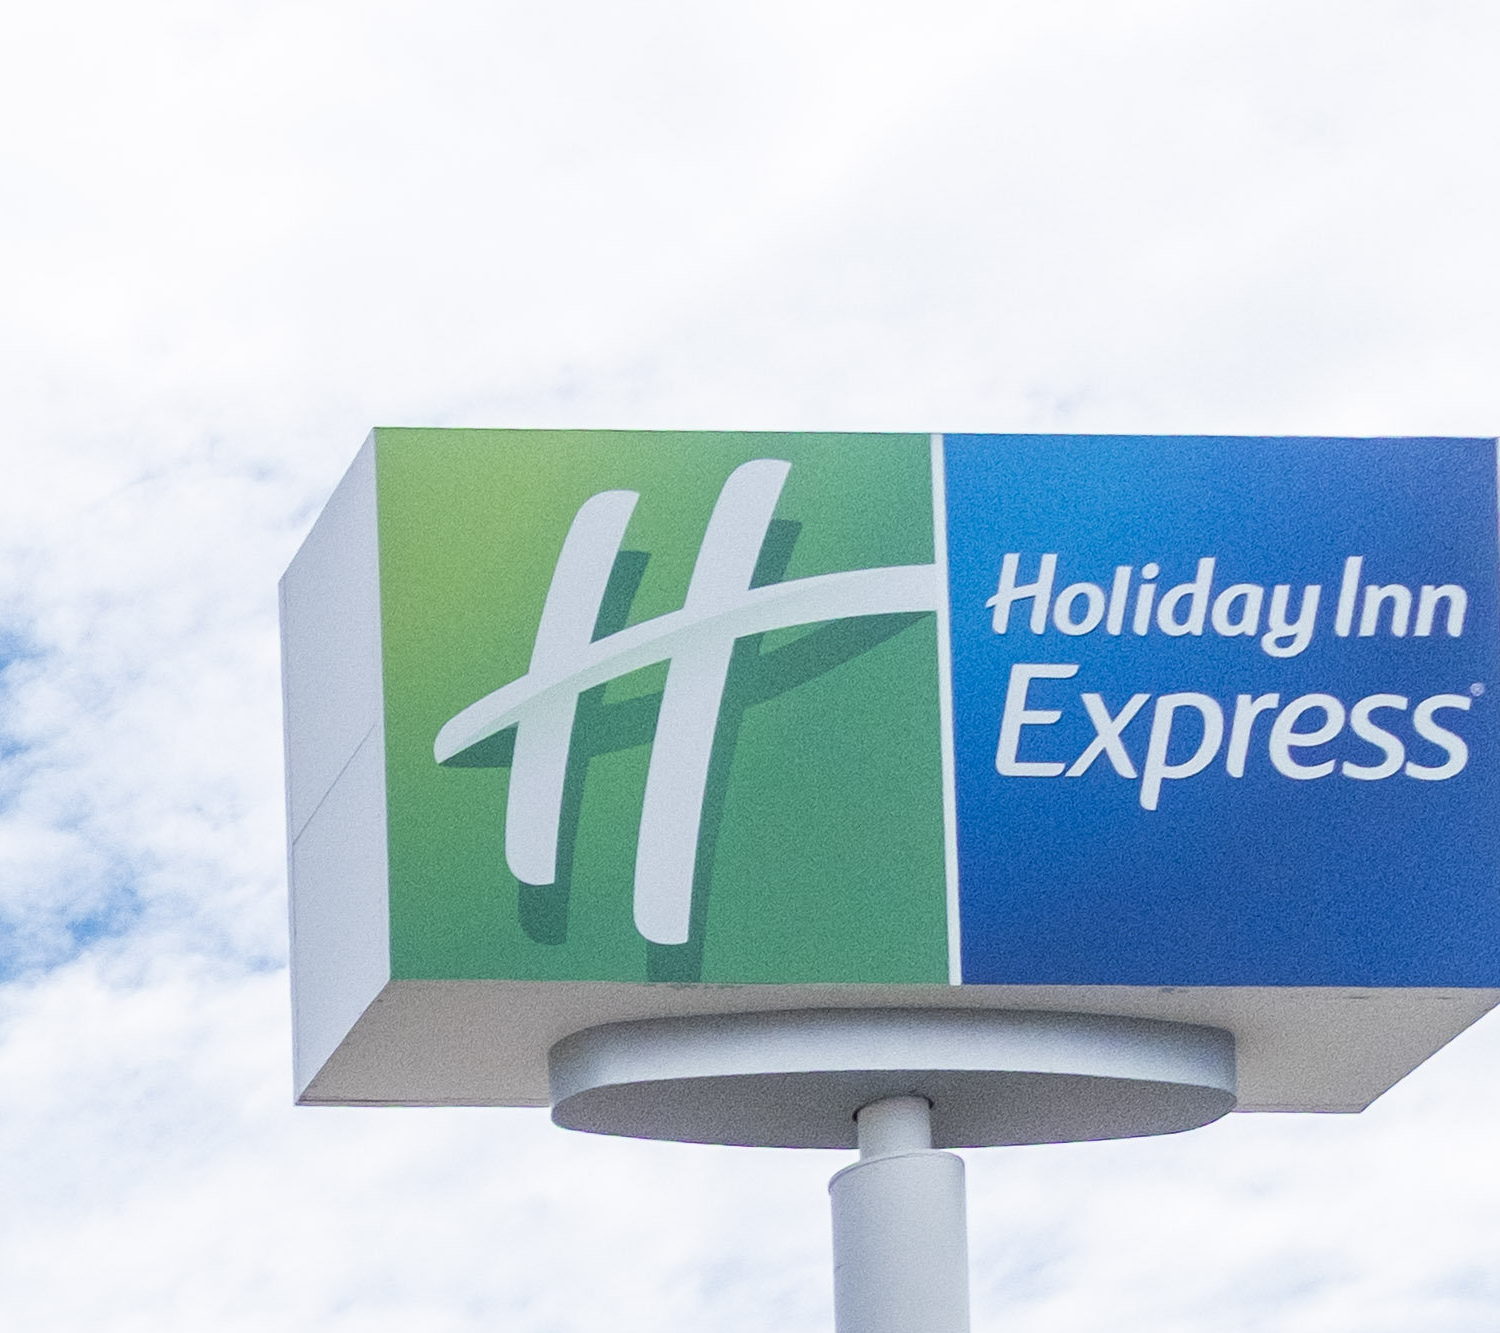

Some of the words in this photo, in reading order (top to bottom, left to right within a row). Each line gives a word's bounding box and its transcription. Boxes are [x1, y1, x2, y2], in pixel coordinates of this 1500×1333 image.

[986, 554, 1321, 658] Holiday
[1336, 556, 1467, 637] Inn
[996, 664, 1472, 811] Express
